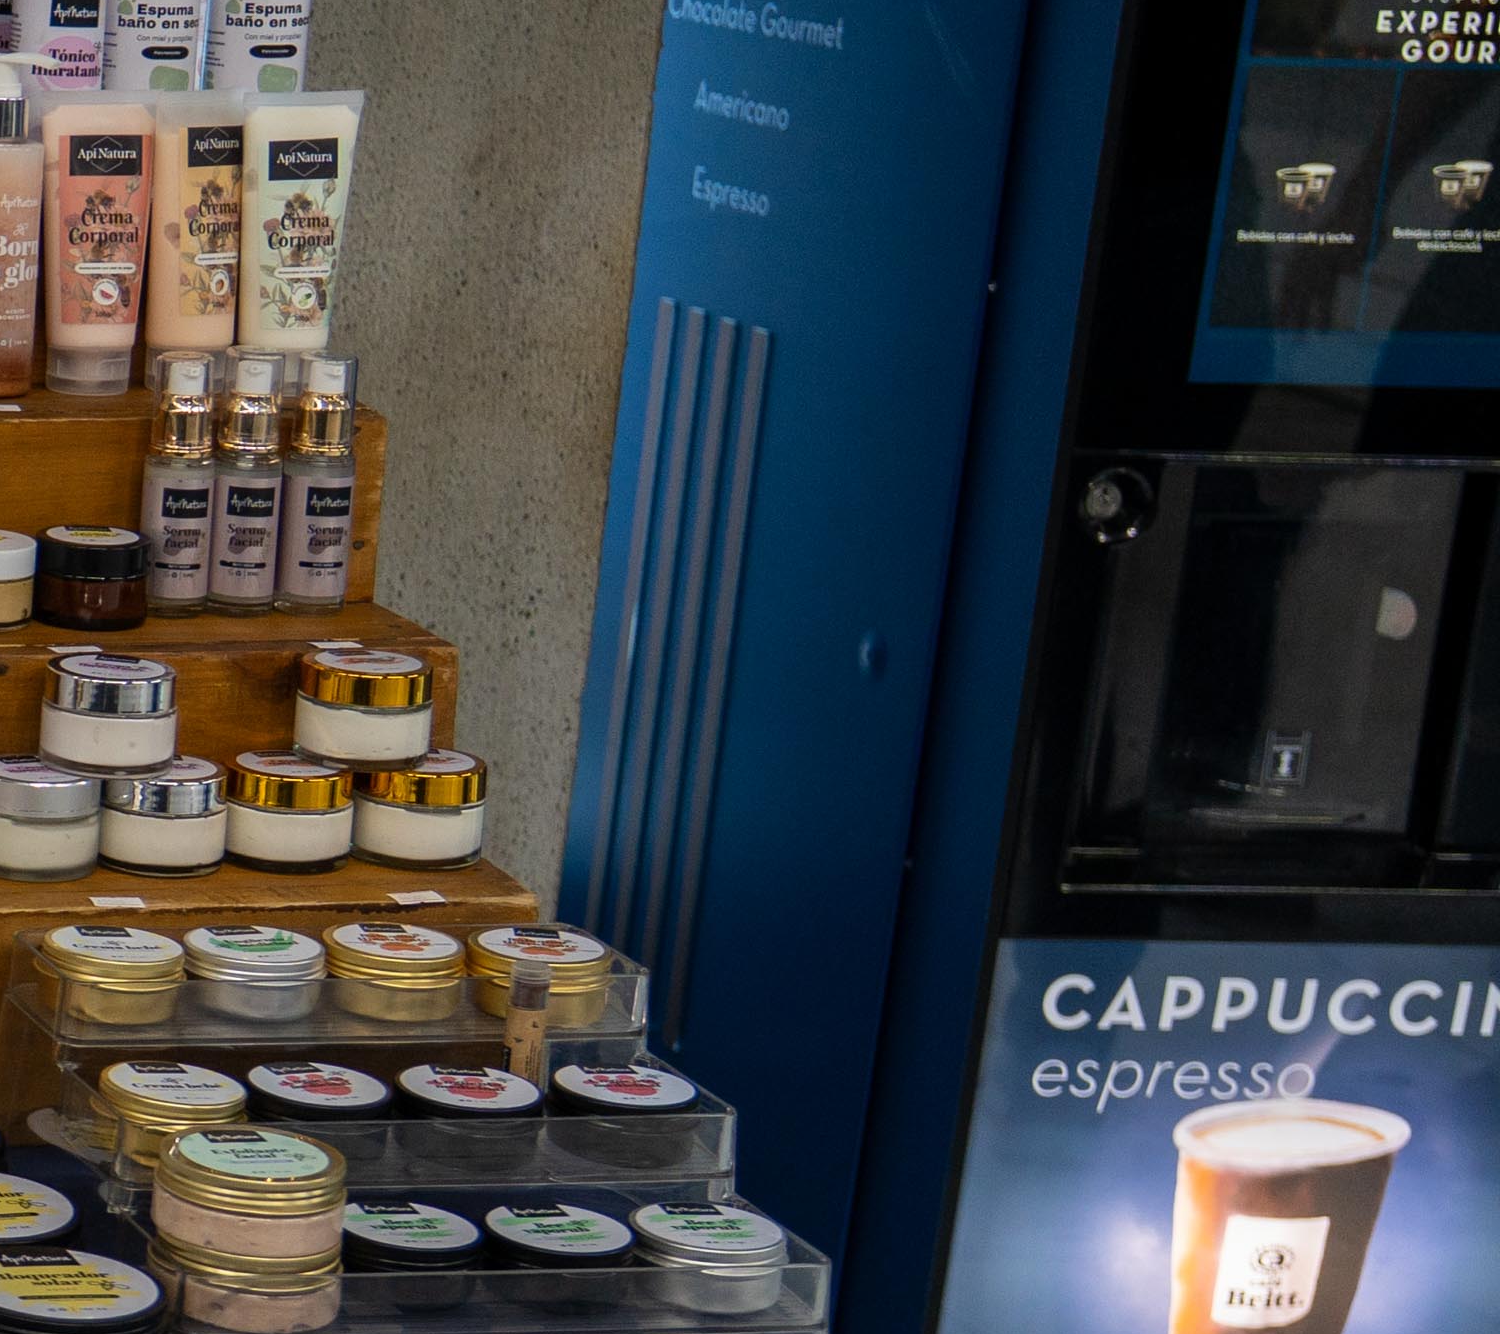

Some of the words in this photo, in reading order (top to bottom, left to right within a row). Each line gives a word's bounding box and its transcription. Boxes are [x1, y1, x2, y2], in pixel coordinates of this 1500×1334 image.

[225, 14, 263, 28] baño
[266, 18, 287, 27] en
[245, 2, 302, 16] Espuma
[760, 2, 845, 51] Gourmet
[1376, 9, 1500, 35] EXPERI
[1401, 39, 1500, 64] GOUR
[695, 80, 790, 133] Americano
[277, 151, 295, 166] Api
[297, 151, 333, 164] Natura
[691, 166, 770, 216] Espresso
[80, 209, 133, 226] Crema
[68, 226, 139, 247] Corporal
[1033, 1056, 1316, 1113] espresso
